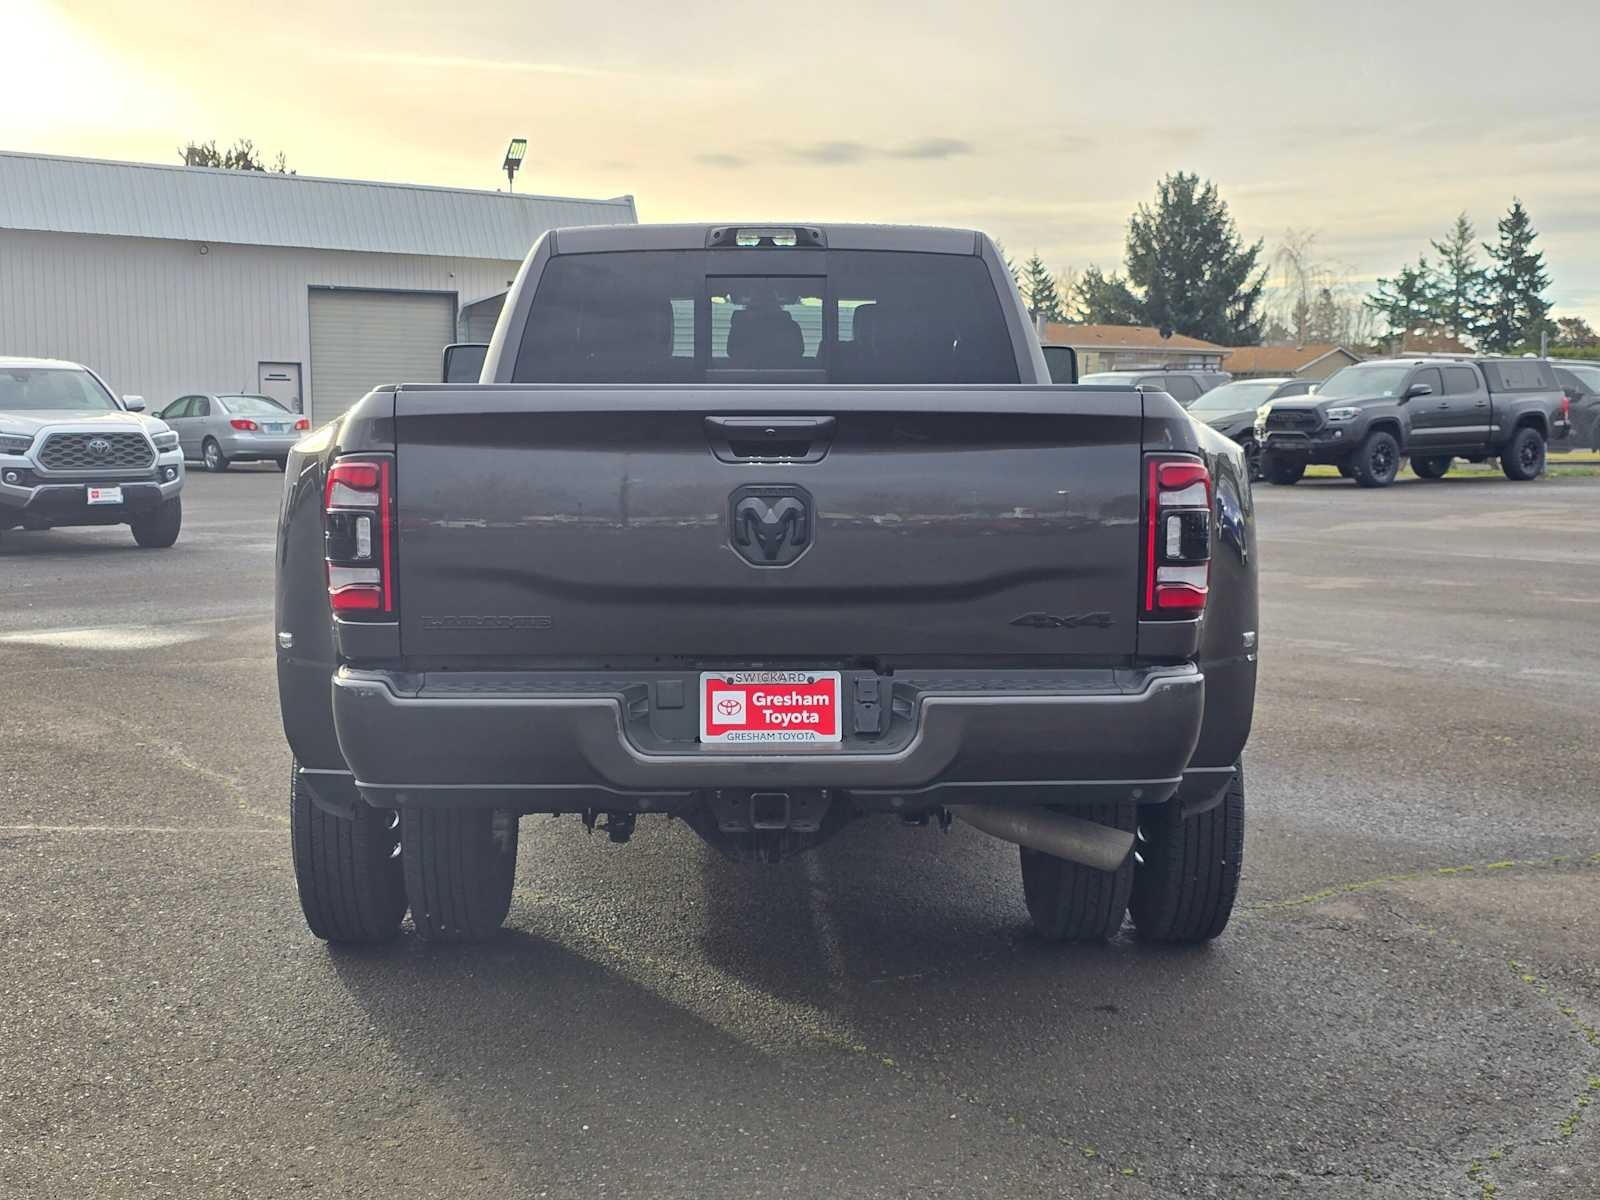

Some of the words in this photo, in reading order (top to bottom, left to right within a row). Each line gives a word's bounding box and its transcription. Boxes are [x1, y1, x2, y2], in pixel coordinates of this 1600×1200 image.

[735, 673, 806, 683] SWICKARD
[752, 691, 829, 706] Gresham
[762, 709, 820, 727] Toyota
[727, 732, 776, 741] GRESHAM
[778, 732, 816, 741] TOYOTA
